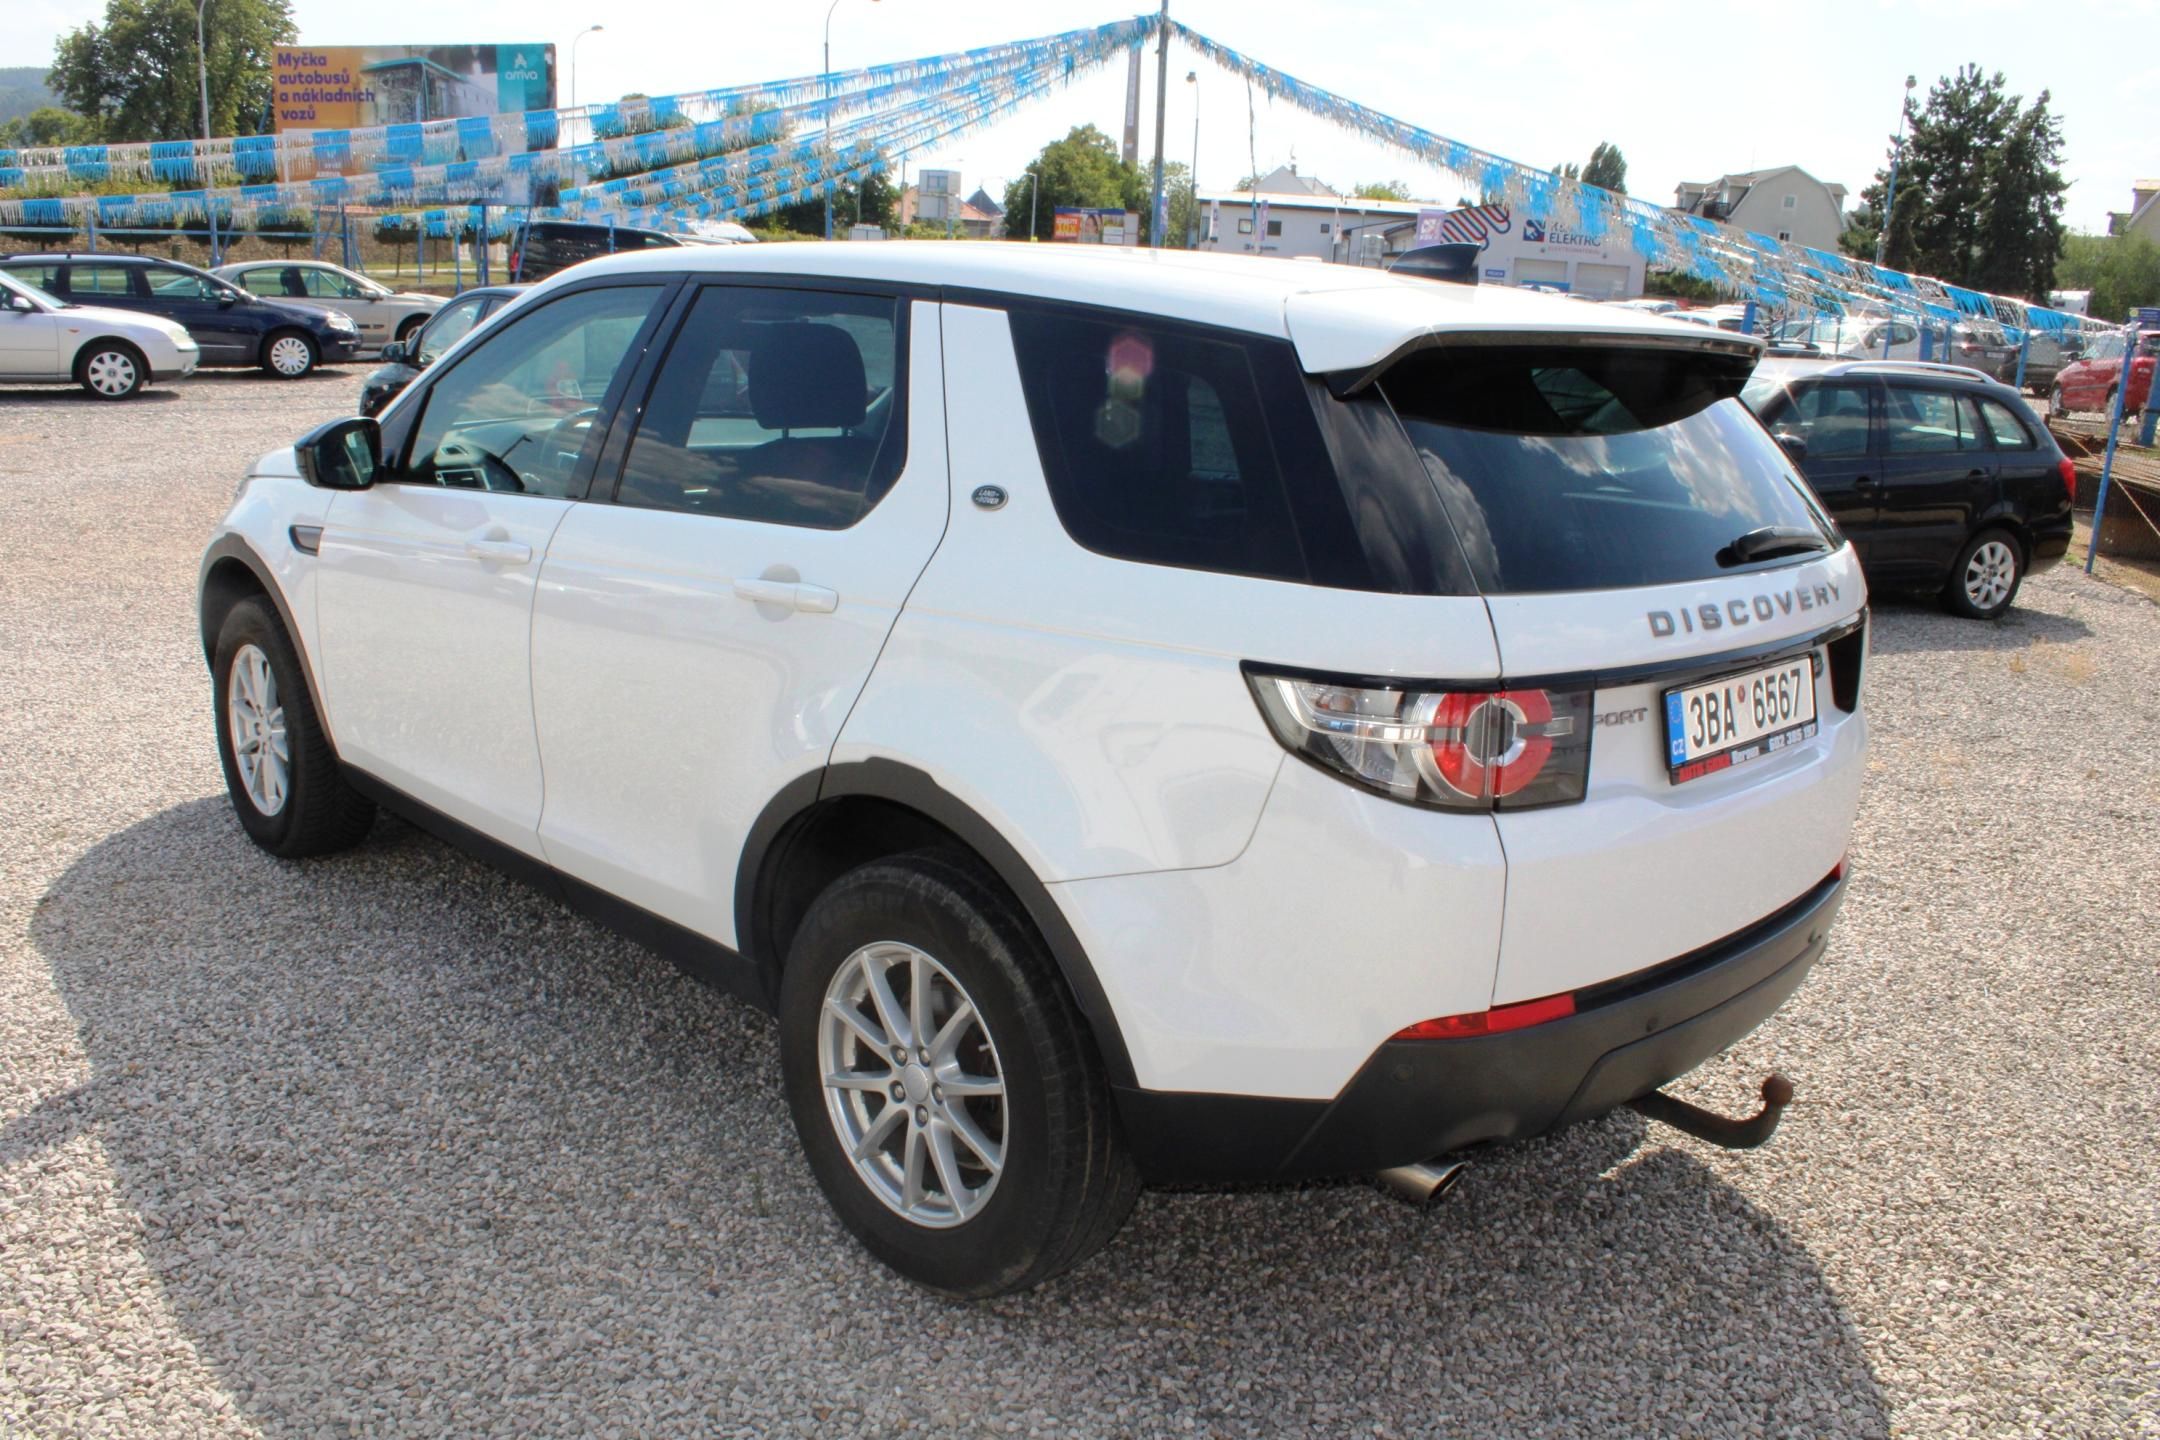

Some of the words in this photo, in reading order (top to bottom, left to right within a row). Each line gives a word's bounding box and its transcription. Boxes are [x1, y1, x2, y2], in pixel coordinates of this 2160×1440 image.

[278, 52, 327, 70] Myčka
[279, 67, 350, 84] autobusů
[280, 92, 289, 103] a
[292, 87, 376, 103] nákladních
[281, 104, 316, 120] vozů
[1647, 582, 1841, 638] DISCOVERY
[1689, 687, 1737, 749] 3BA
[1752, 667, 1801, 729] 6567
[1672, 738, 1685, 755] CZ
